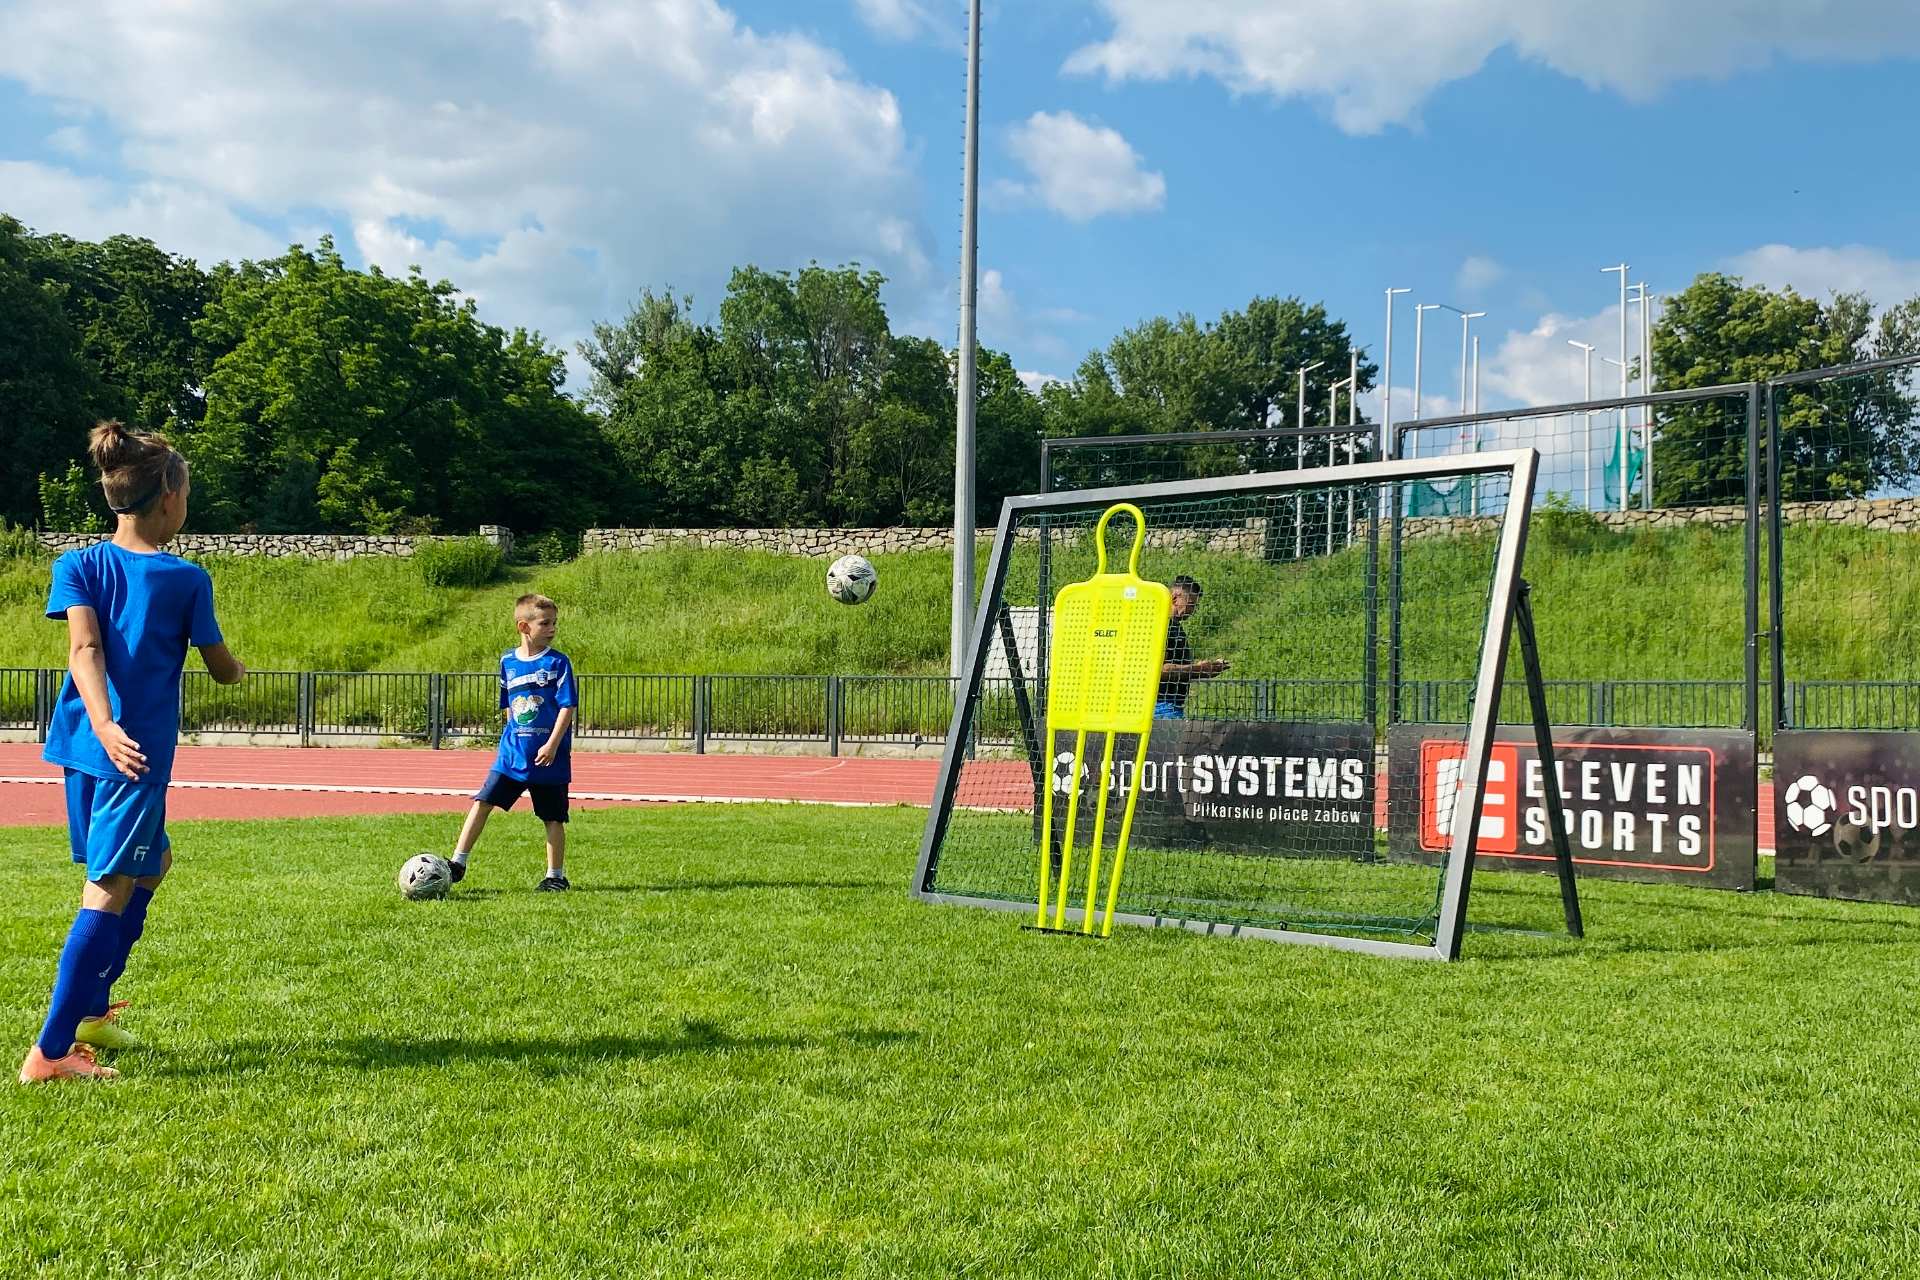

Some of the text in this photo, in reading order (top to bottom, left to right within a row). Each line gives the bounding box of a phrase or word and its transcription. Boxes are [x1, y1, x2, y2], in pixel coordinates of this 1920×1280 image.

[1094, 629, 1118, 638] SELECT
[1525, 759, 1702, 806] ELEVEN
[1193, 802, 1360, 824] Piłkarskie place zabaw
[1847, 785, 1918, 835] spo
